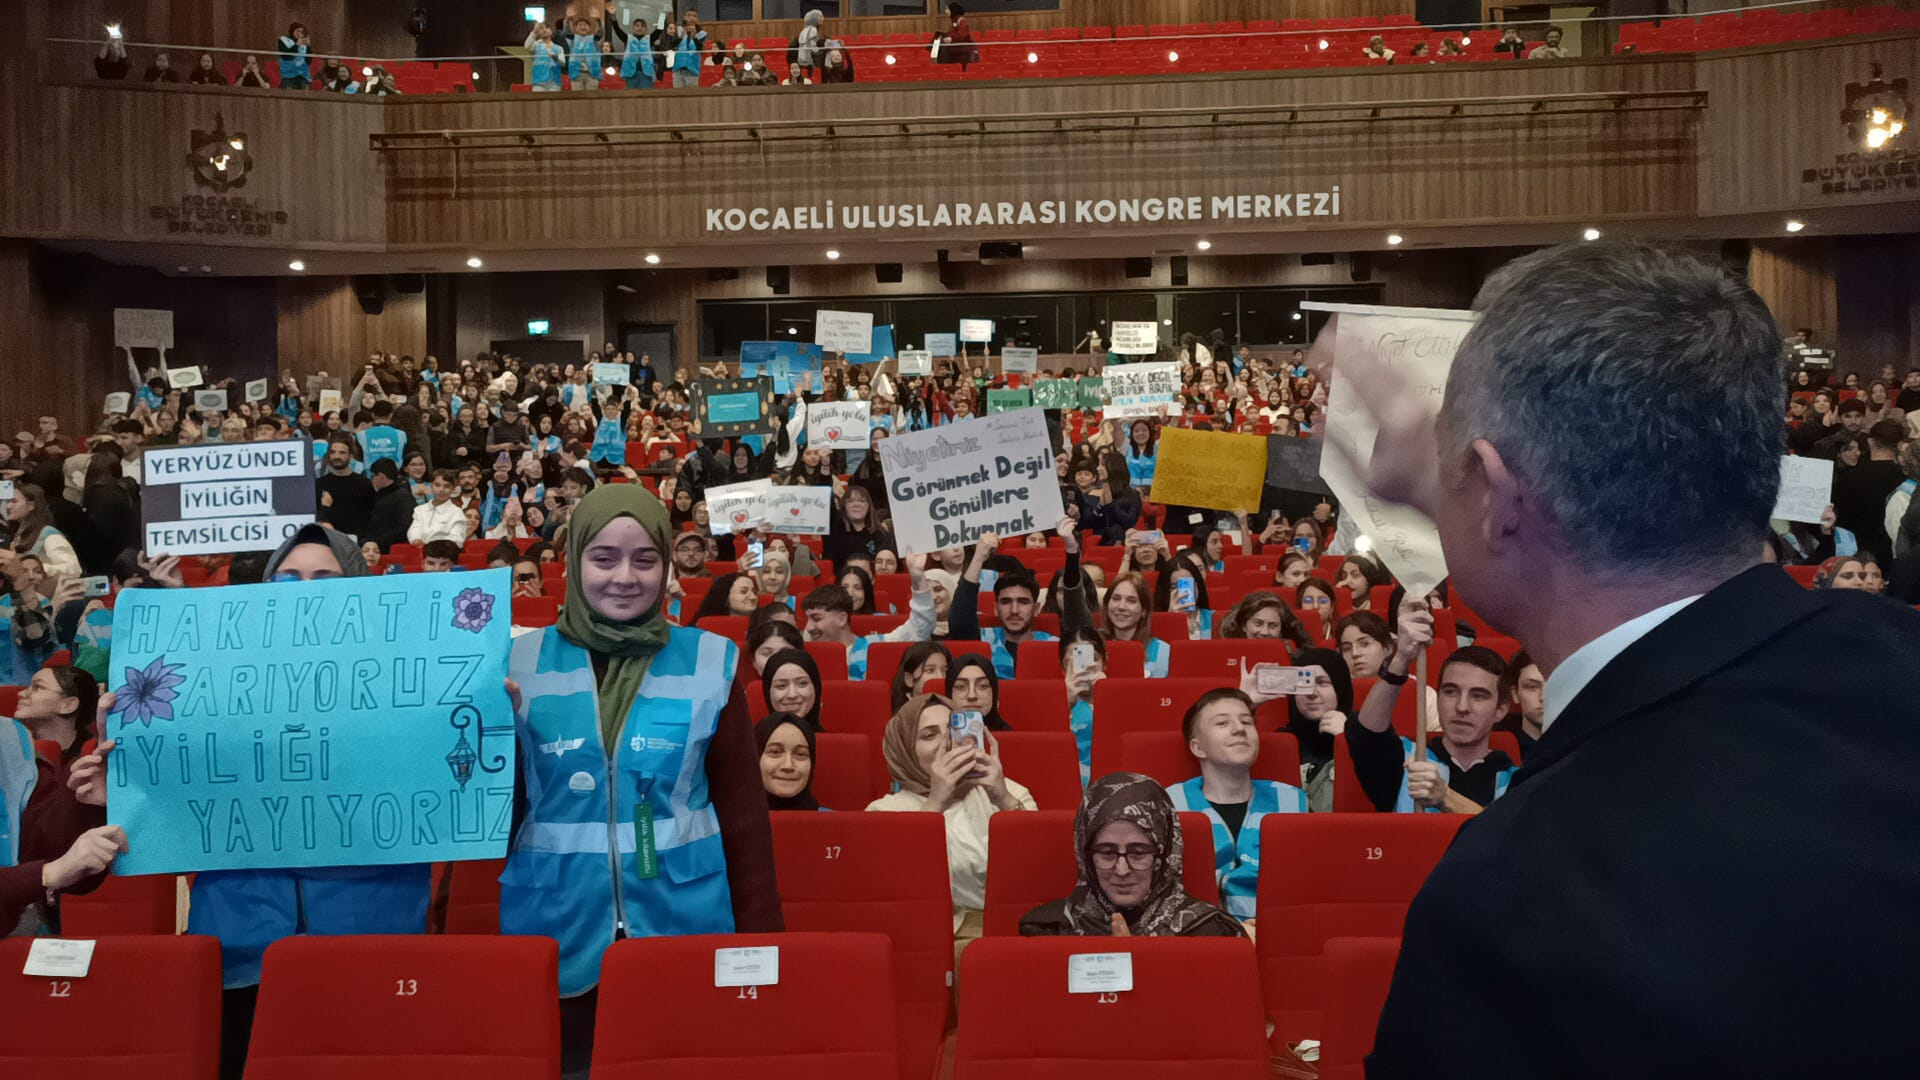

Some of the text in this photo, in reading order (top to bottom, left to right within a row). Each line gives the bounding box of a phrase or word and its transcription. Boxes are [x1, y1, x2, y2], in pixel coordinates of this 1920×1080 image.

[706, 185, 1340, 231] KOCAELİ ULUSLARARASI KONGRE MERKEZİ
[150, 449, 298, 475] YERYÜZÜNDE
[891, 448, 1051, 502] Görünmek Değil
[184, 485, 268, 510] İYİLİĞİN
[928, 487, 1030, 521] Gönüllere
[149, 520, 304, 547] TEMSİLCİSİ O
[181, 654, 484, 717] ARIYORUZ
[114, 723, 330, 788] İYİLİĞİ
[188, 786, 515, 854] YAYIYORUZ
[825, 846, 842, 859] 17
[1365, 846, 1383, 860] 19
[49, 980, 71, 997] 12
[395, 979, 418, 996] 13
[736, 985, 758, 1000] 14
